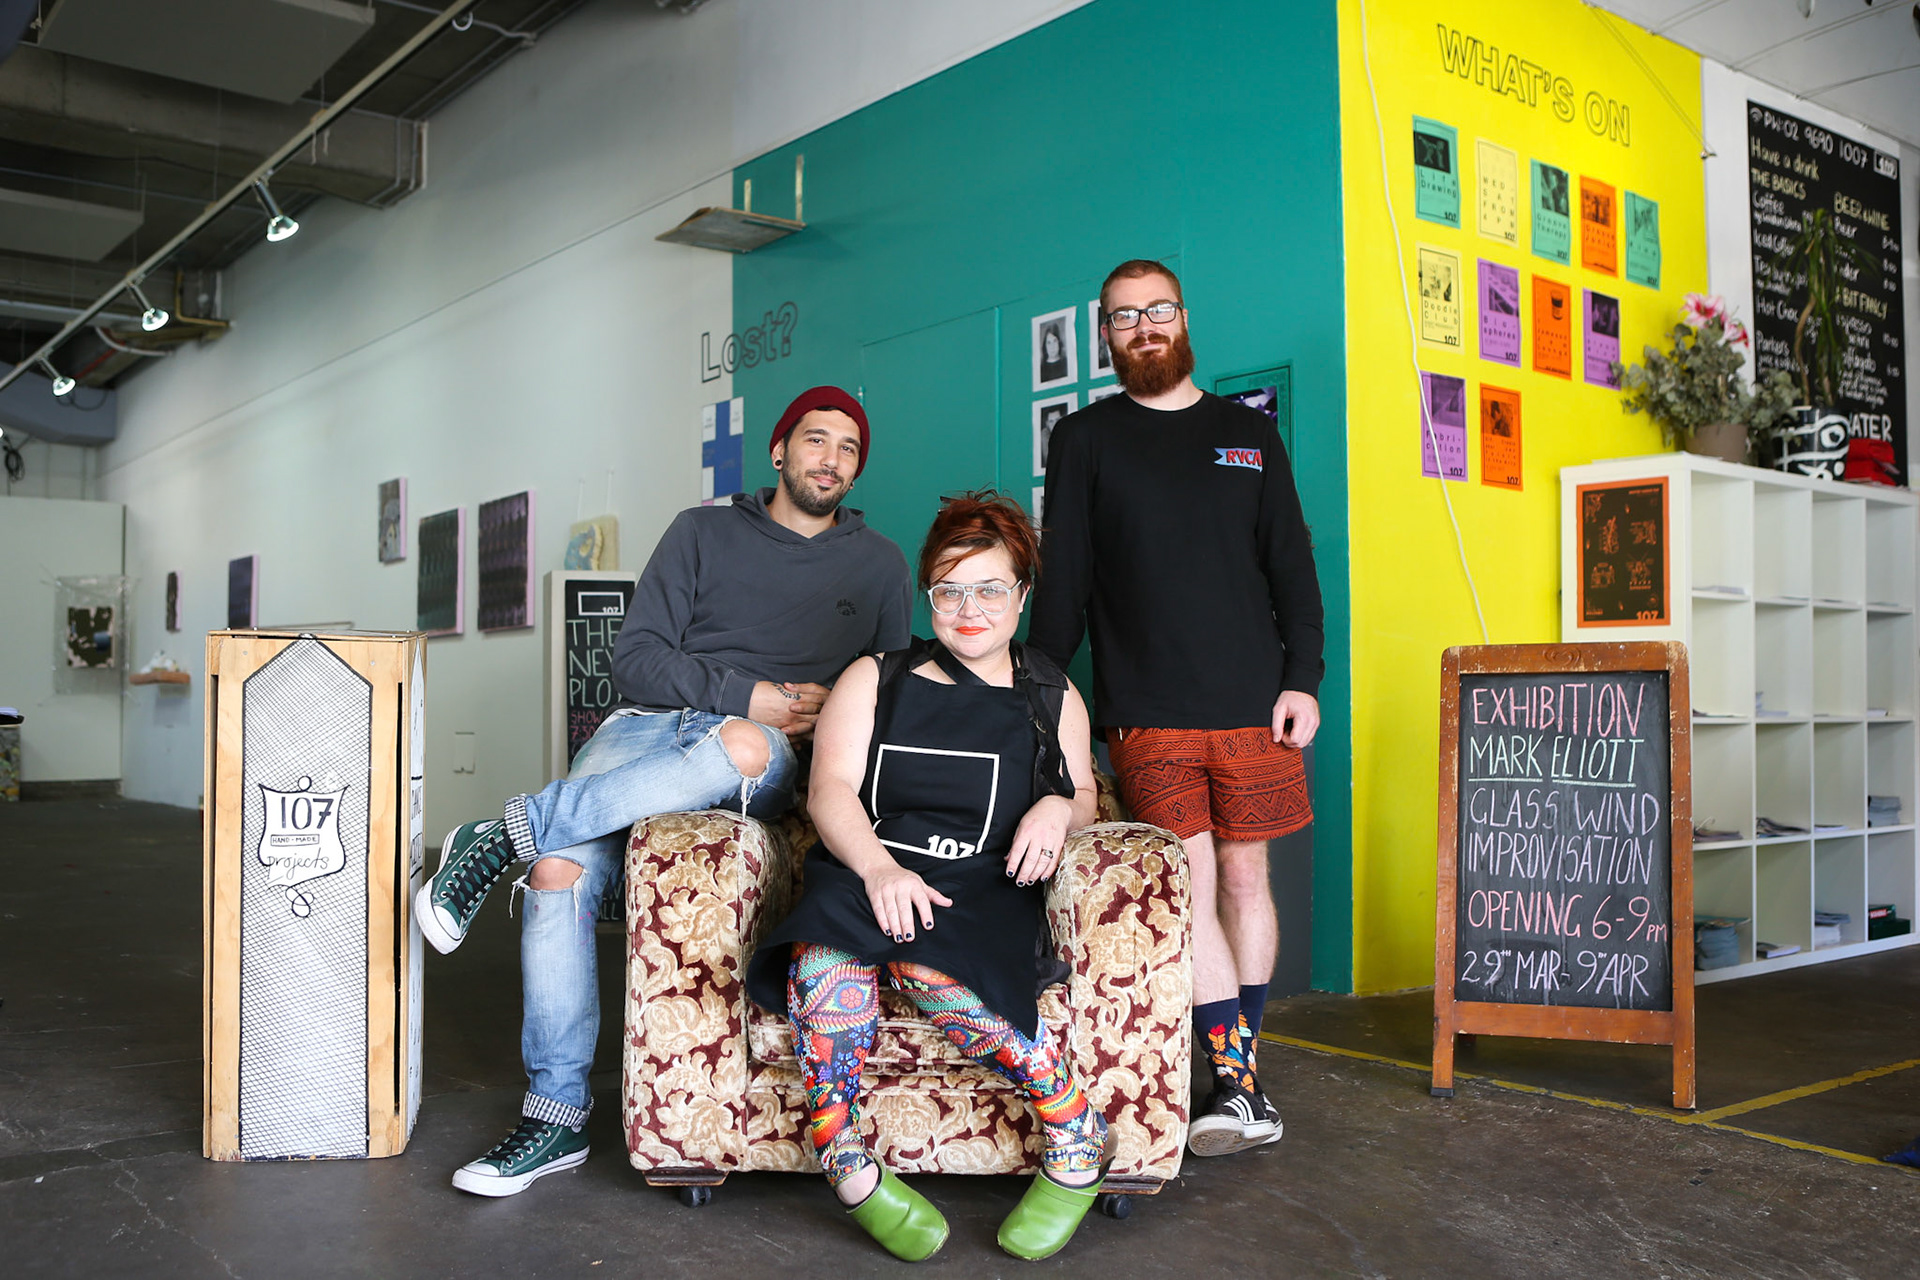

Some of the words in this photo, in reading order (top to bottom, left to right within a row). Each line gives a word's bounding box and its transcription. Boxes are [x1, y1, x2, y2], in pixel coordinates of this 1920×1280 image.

[1437, 23, 1576, 123] WHAT'S
[1585, 91, 1630, 147] ON
[1750, 135, 1780, 167] Have
[1783, 154, 1791, 168] a
[1793, 153, 1820, 181] drink
[1804, 126, 1834, 155] 9690
[1839, 140, 1868, 168] 1007
[1751, 167, 1771, 188] THE
[1771, 173, 1807, 200] BASICS
[1424, 300, 1458, 314] Doodle
[1756, 294, 1775, 316] Hot
[1842, 287, 1859, 308] BIT
[1424, 310, 1458, 325] Club
[702, 301, 798, 383] Lost?
[1444, 335, 1457, 346] 107
[1848, 412, 1893, 443] ATER
[1226, 449, 1263, 467] RVCA
[1450, 467, 1463, 477] 107
[1507, 476, 1519, 486] 107
[602, 606, 619, 615] 107
[1636, 610, 1659, 620] 107
[566, 618, 623, 648] THE
[569, 678, 622, 708] PLO
[1472, 683, 1645, 737] EXHIBITION
[1470, 734, 1544, 777] MARK
[1550, 735, 1645, 782] ELIOTT
[281, 796, 334, 830] 107
[1470, 787, 1560, 829] GLASS
[1574, 790, 1660, 836] WIND
[927, 834, 976, 860] 107
[1468, 831, 1654, 885] IMPROVISATION
[267, 847, 330, 881] projects
[1468, 890, 1583, 938] OPENING
[1595, 953, 1650, 997] APR
